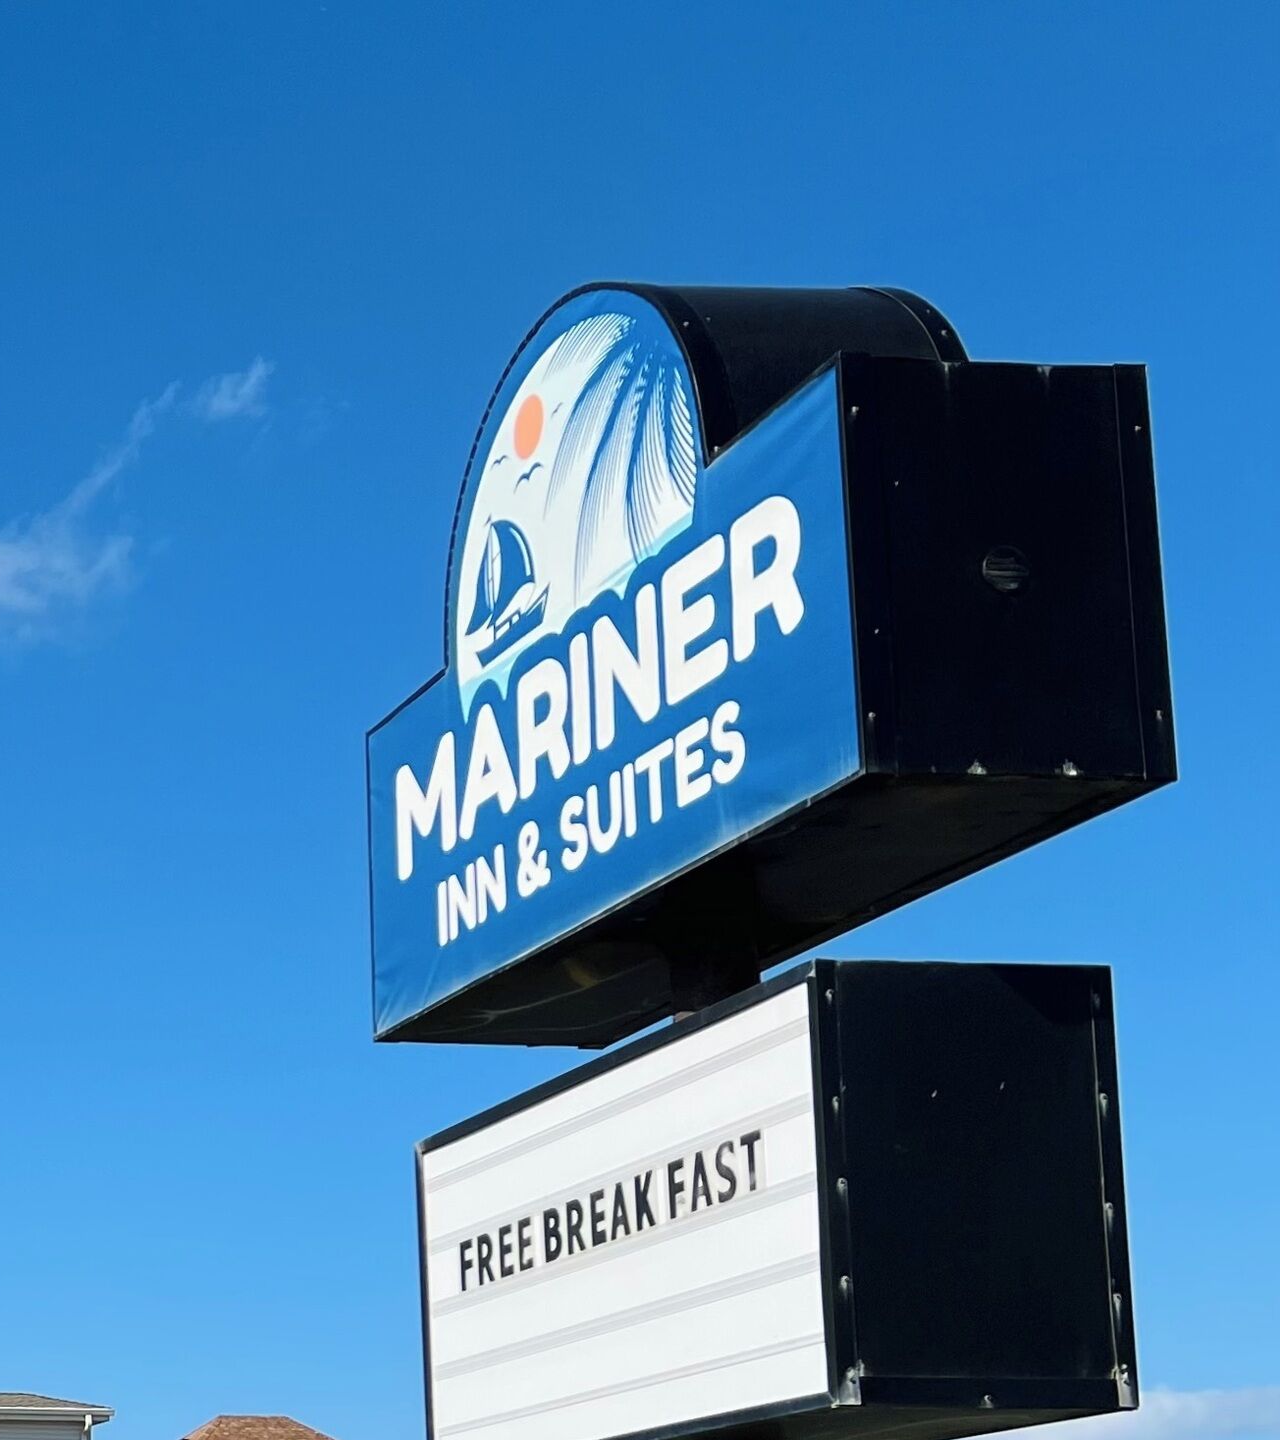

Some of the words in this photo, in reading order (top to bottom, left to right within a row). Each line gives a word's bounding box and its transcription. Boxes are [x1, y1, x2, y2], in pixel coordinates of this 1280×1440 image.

[395, 495, 805, 881] MARINER
[437, 844, 507, 946] INN
[517, 820, 551, 898] &
[559, 700, 746, 871] SUITES
[459, 1216, 534, 1292] FREE
